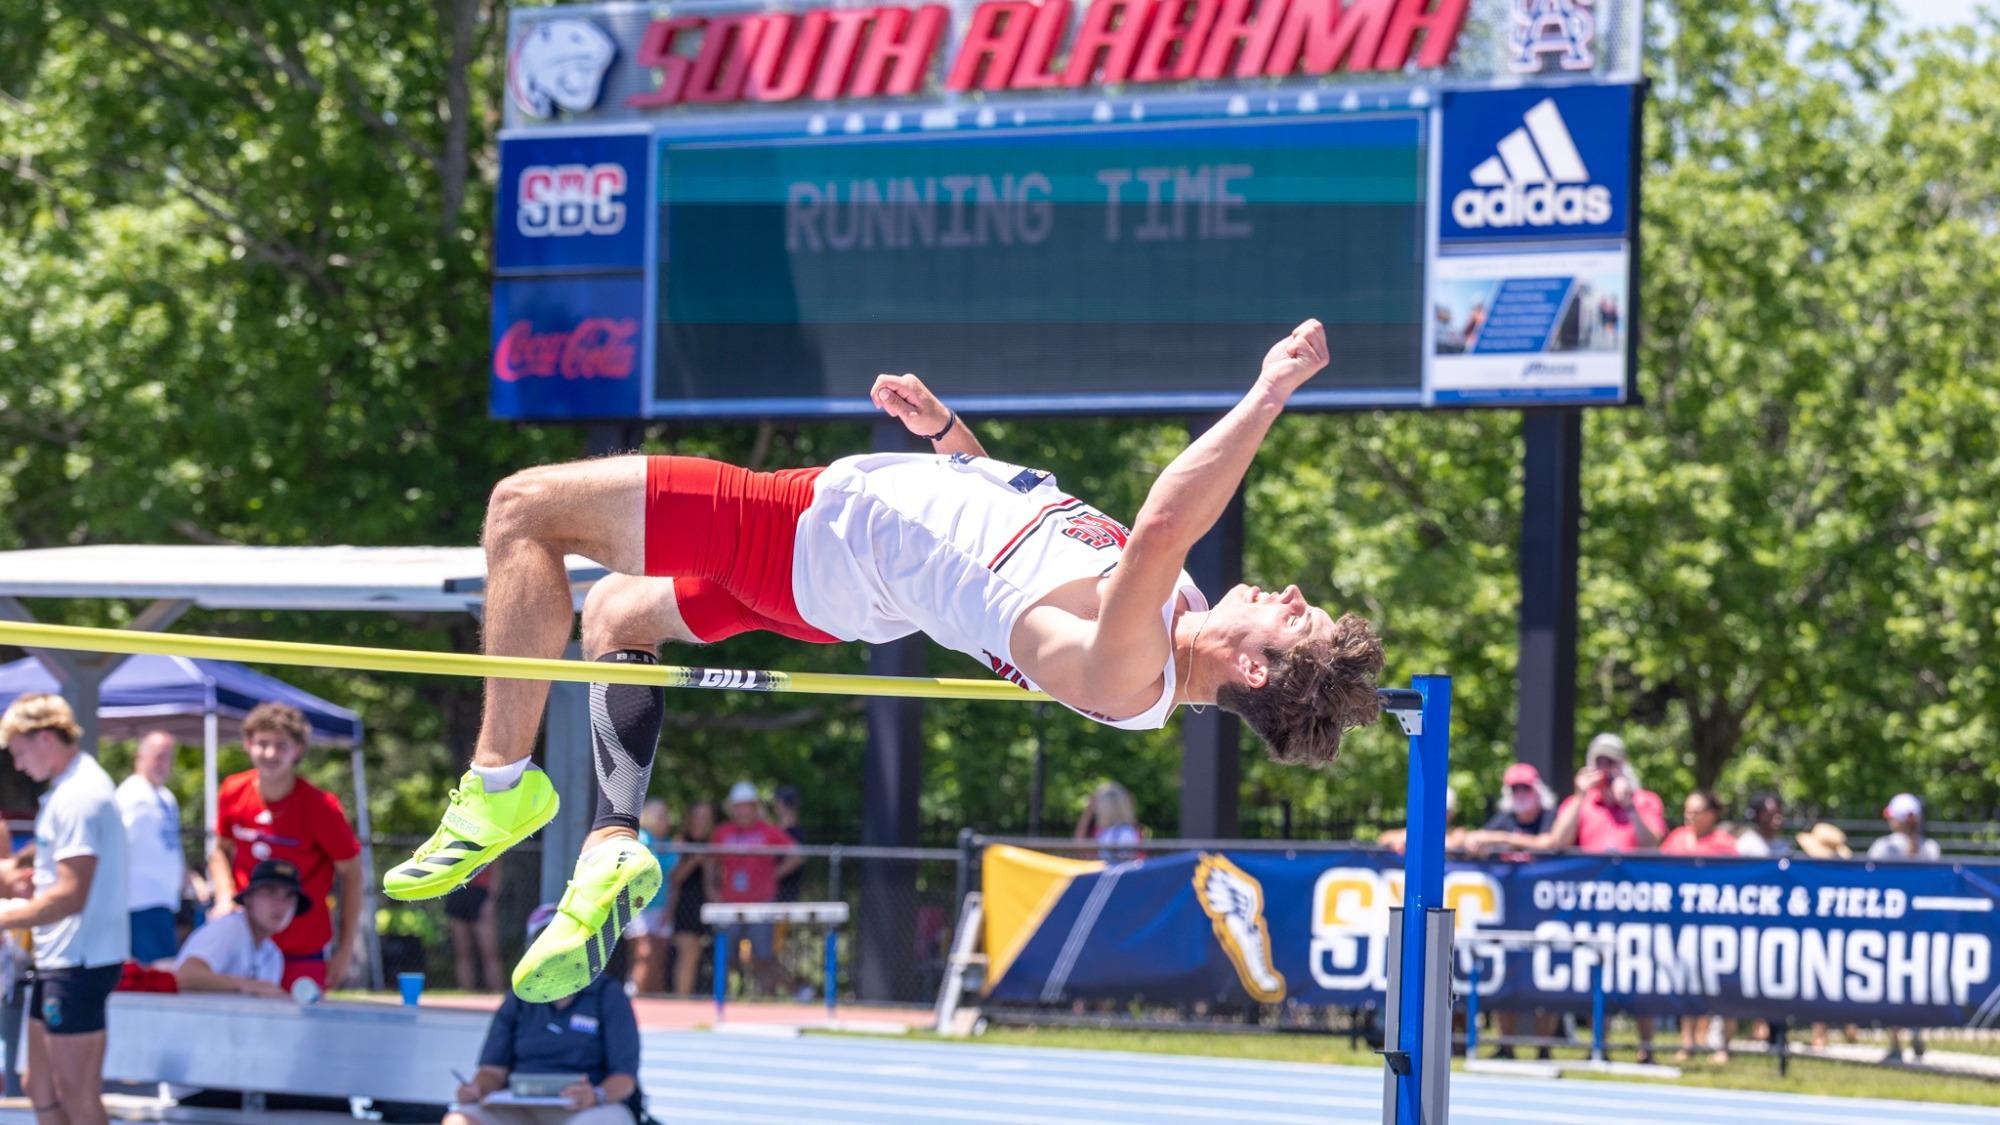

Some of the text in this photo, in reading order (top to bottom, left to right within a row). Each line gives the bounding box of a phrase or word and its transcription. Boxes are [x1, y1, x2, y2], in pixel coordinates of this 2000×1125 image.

[625, 0, 1473, 108] SOUTH ALABAMA
[516, 162, 628, 238] SBC
[785, 163, 1254, 253] RUNNING TIME
[1452, 179, 1613, 229] adidas
[699, 667, 758, 689] GILL
[1310, 867, 1506, 996] SC
[1533, 879, 1673, 914] OUTDOOR
[1677, 882, 1783, 916] TRACK
[1787, 885, 1811, 917] &
[1814, 886, 1908, 919] FIELD
[1532, 920, 1992, 1007] CHAMPIONSHIP
